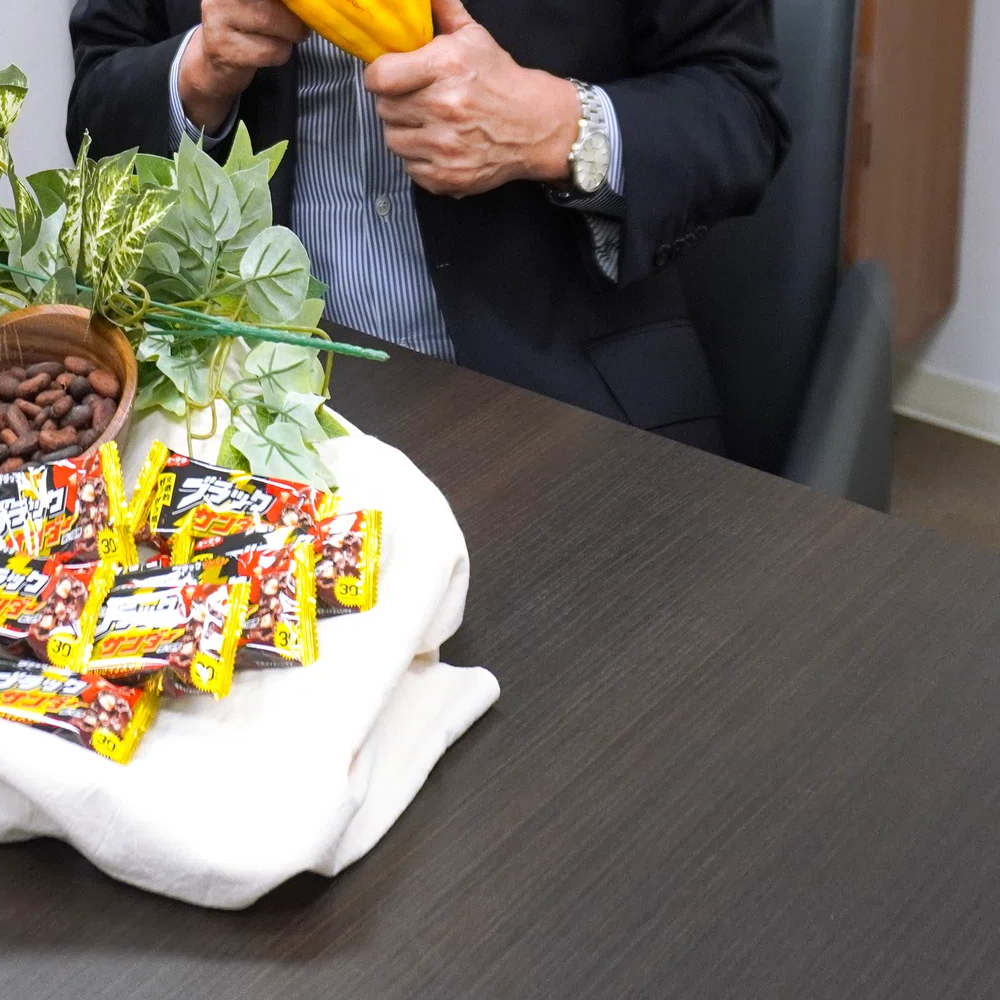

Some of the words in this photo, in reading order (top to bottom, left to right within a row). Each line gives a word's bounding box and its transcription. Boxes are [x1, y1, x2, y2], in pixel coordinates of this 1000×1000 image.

[172, 476, 276, 515] ブラック
[101, 537, 117, 555] 30
[338, 582, 359, 597] 30
[51, 641, 72, 658] 30
[101, 629, 186, 658] サンダー
[2, 691, 90, 712] サンダー
